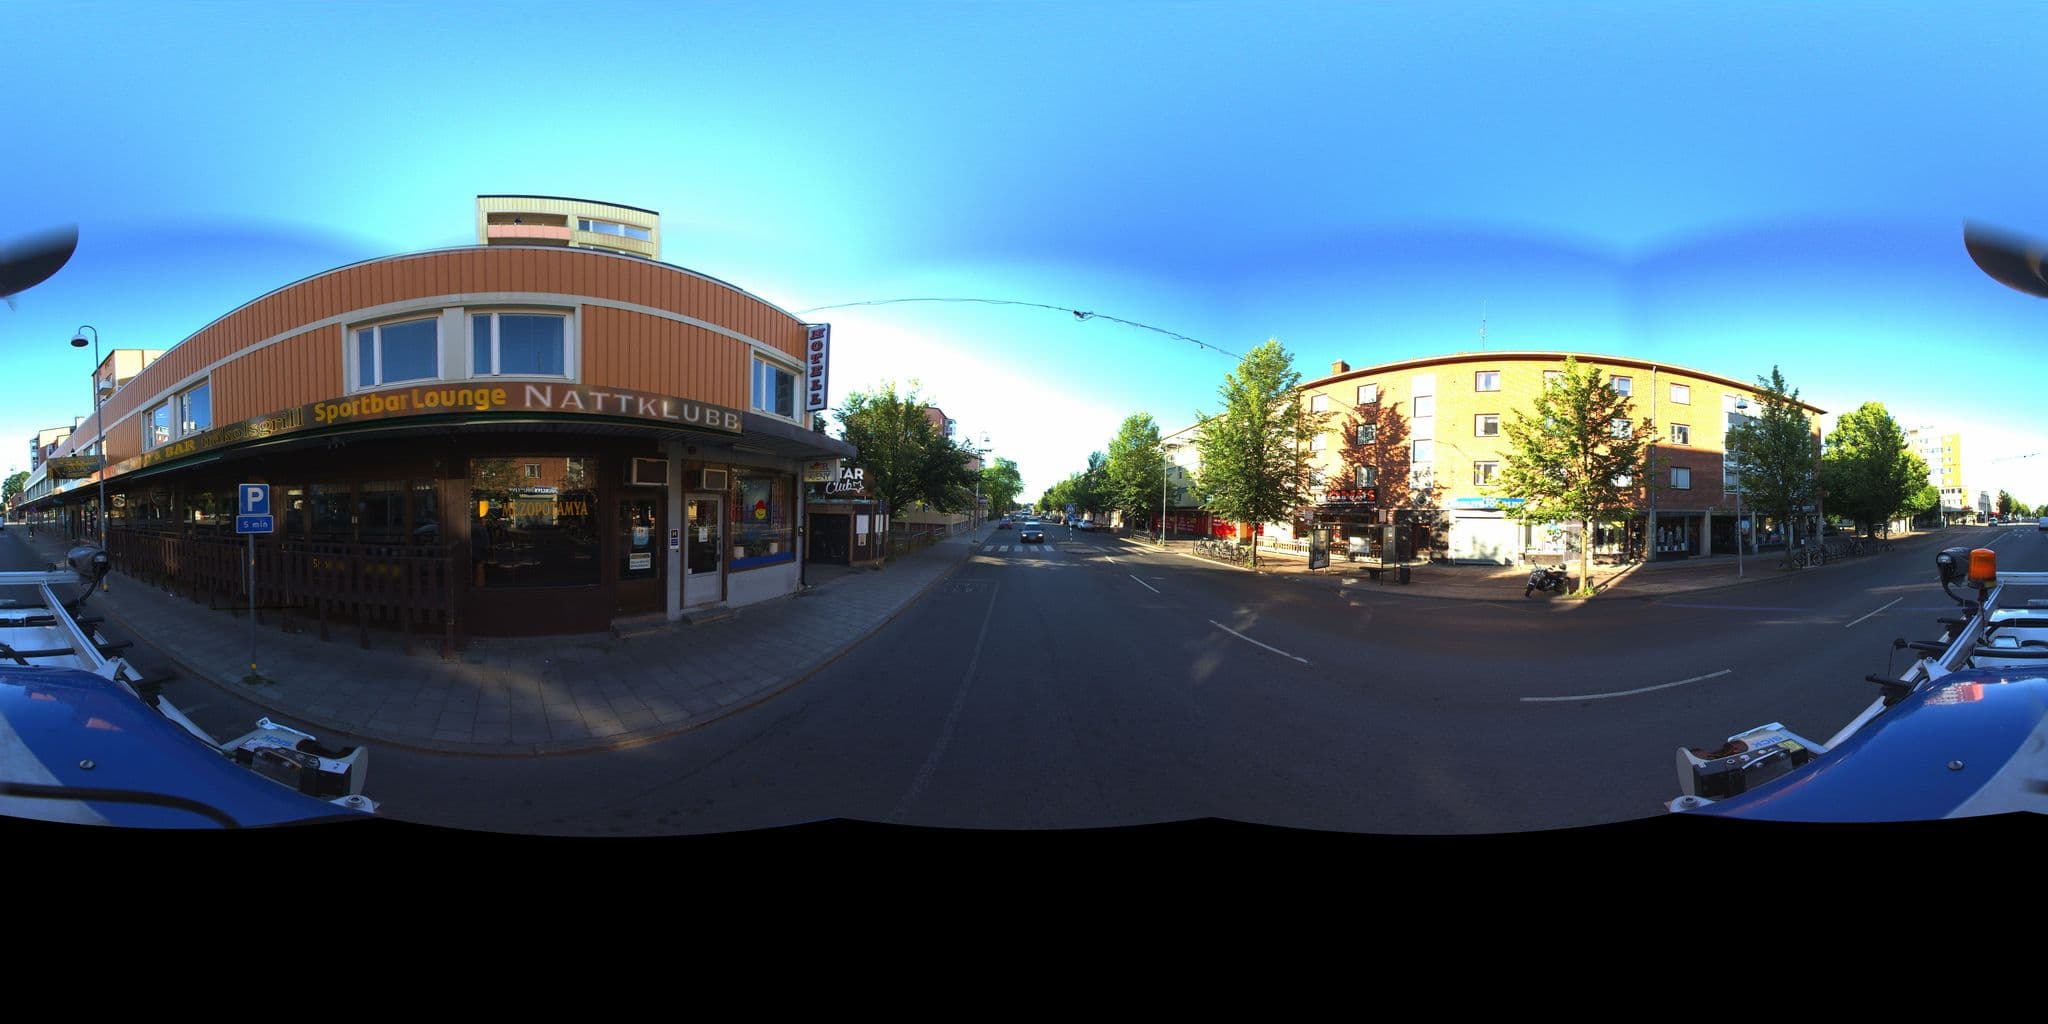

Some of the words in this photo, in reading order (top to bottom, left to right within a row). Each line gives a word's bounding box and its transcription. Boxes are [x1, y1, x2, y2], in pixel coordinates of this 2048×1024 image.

[810, 328, 825, 405] HOTELL
[314, 393, 408, 423] Sportbar
[411, 387, 506, 411] Lounge
[524, 385, 738, 429] NATTKLUBB
[247, 487, 264, 512] P
[825, 479, 853, 495] Club
[502, 501, 588, 517] MEZOPOTAMYA
[243, 520, 249, 529] 5
[252, 520, 268, 529] min
